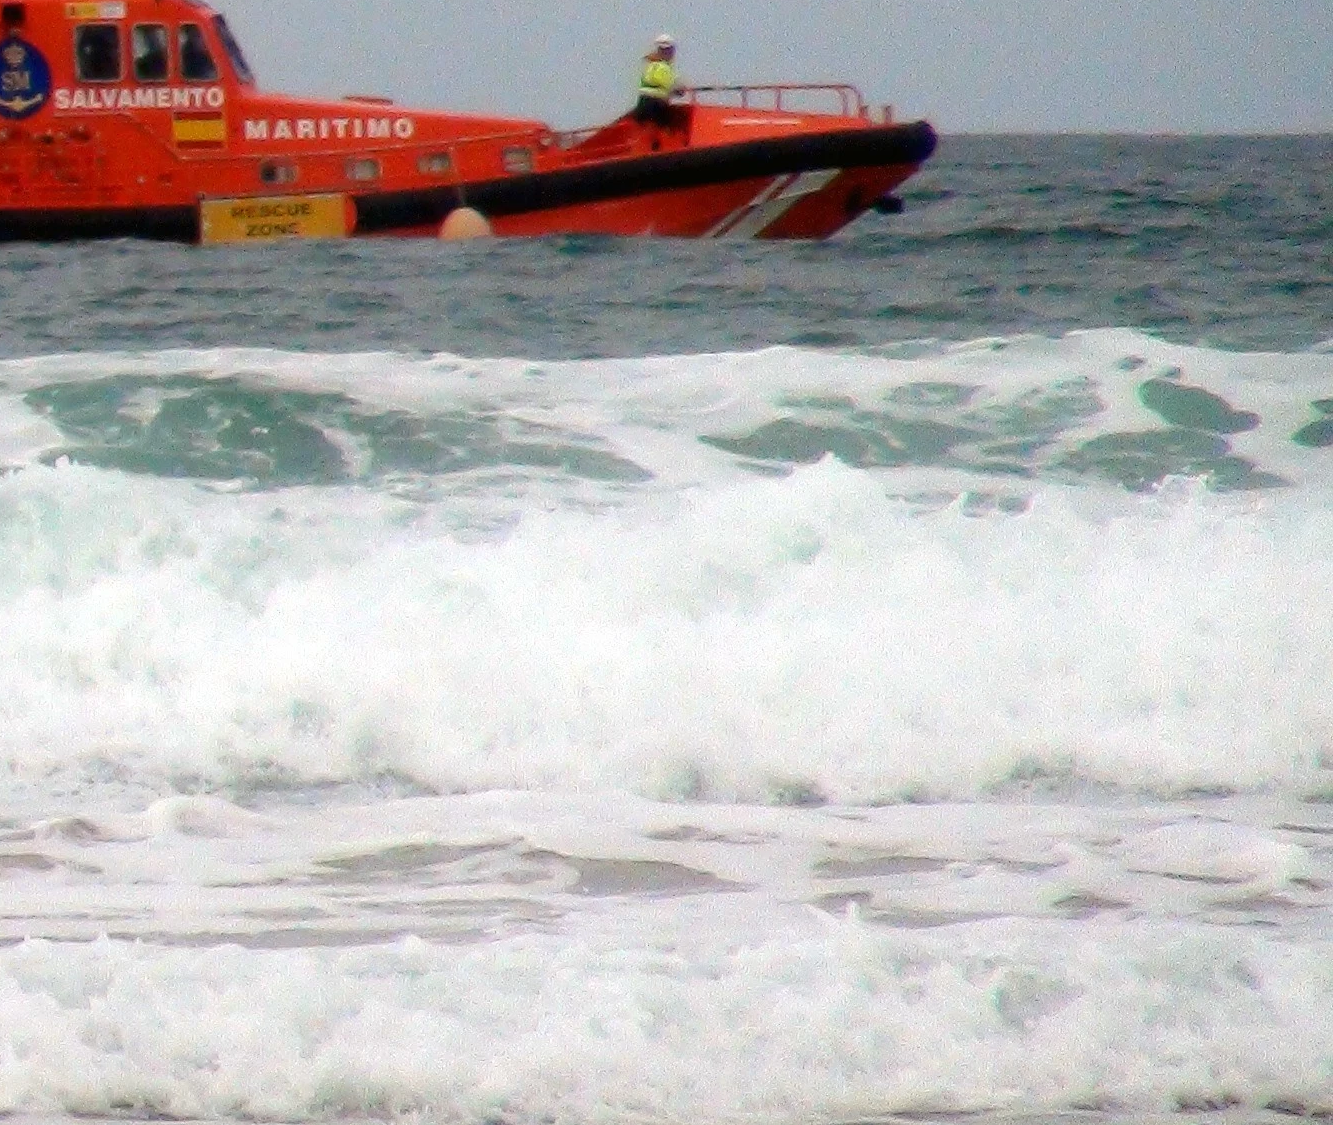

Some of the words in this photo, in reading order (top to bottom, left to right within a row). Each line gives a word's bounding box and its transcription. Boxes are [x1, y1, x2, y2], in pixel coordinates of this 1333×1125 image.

[54, 87, 225, 109] SALVAMENTO
[244, 117, 415, 140] MARITIMO
[230, 202, 311, 218] RESCUE
